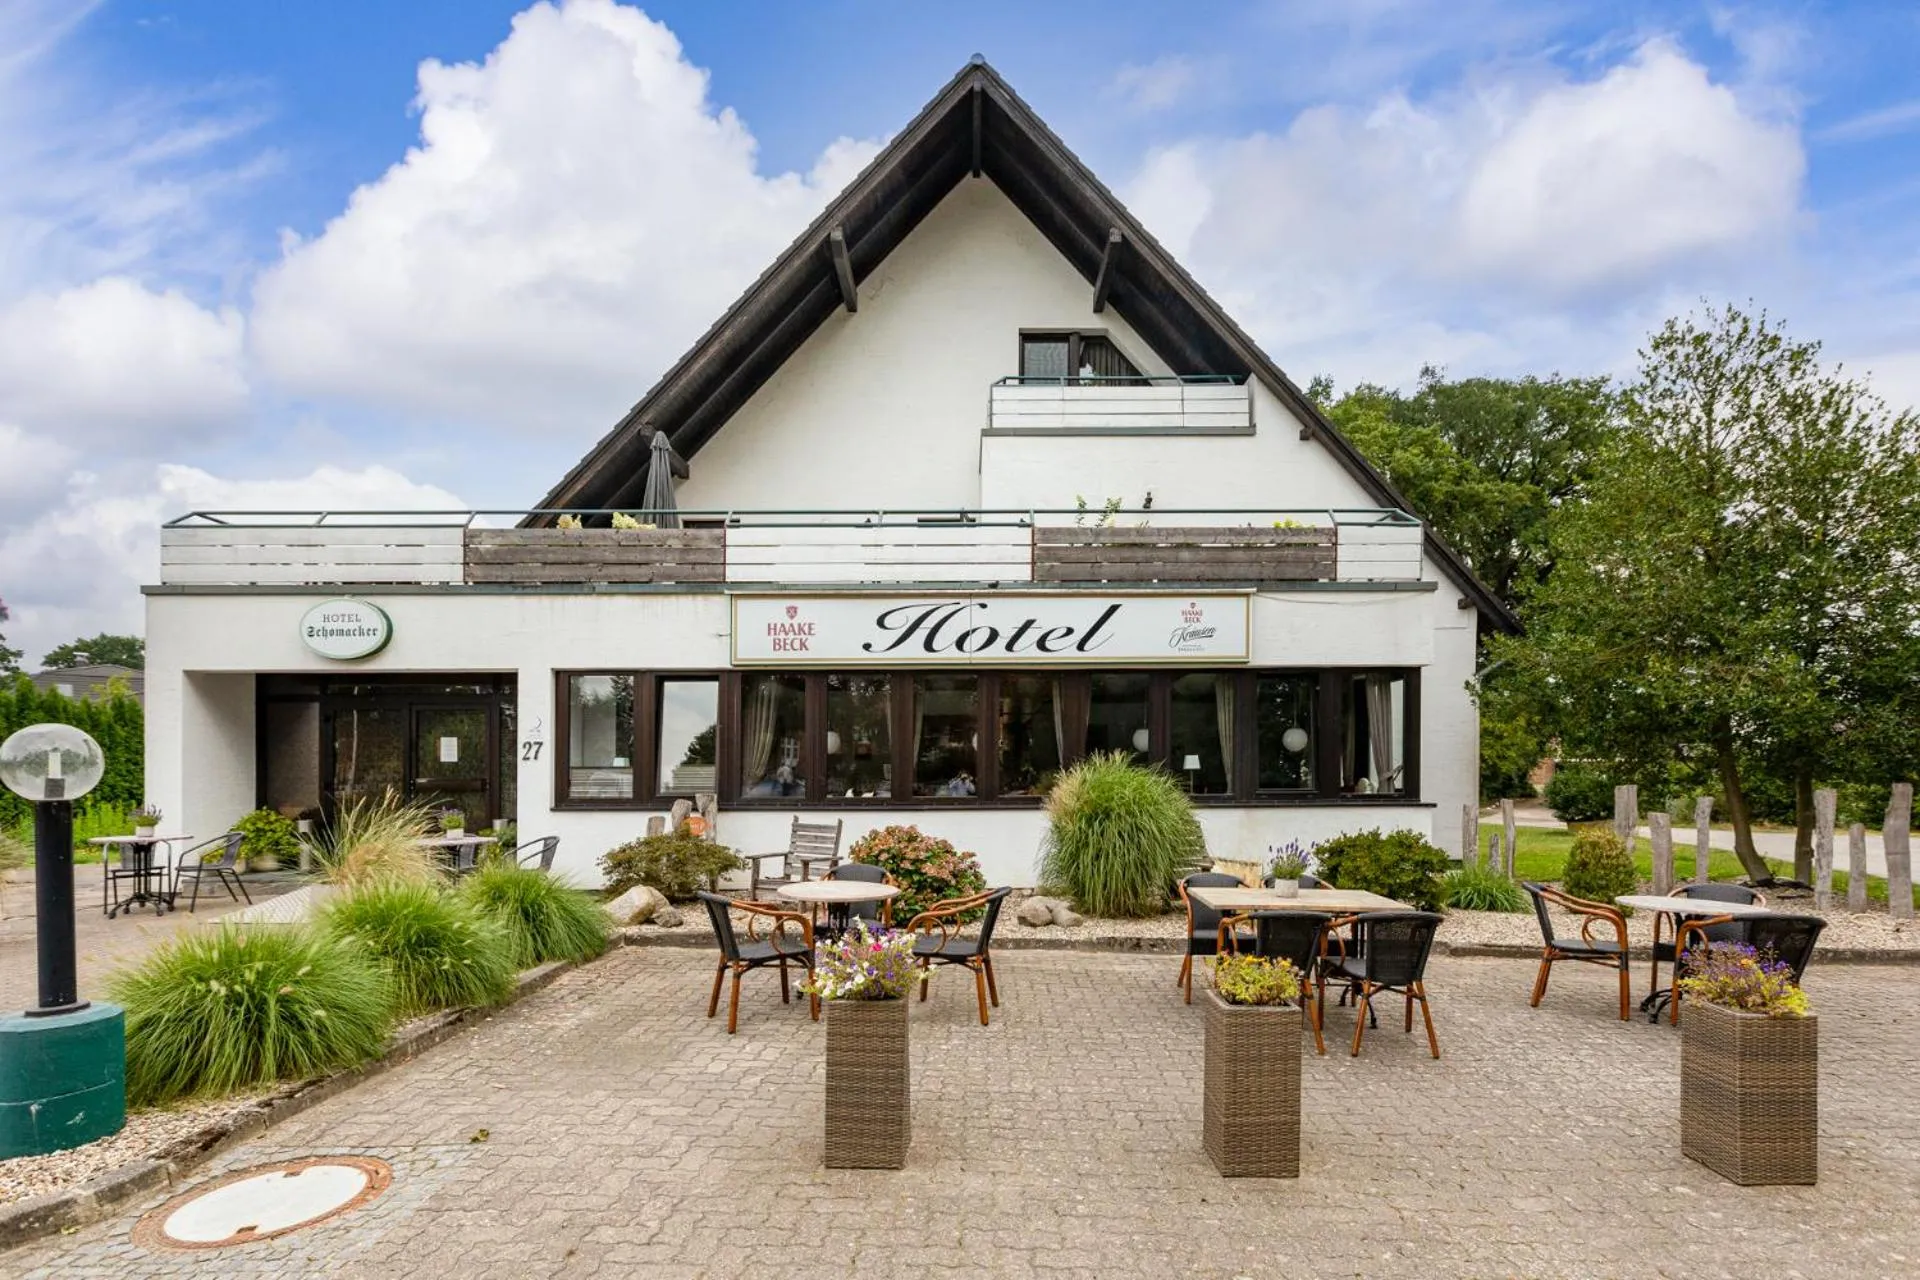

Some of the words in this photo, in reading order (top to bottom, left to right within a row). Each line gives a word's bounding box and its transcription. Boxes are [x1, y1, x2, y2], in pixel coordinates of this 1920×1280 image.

[322, 613, 362, 623] HOTEL
[306, 625, 378, 640] Schomacker
[767, 622, 816, 636] HAAKE
[862, 602, 1123, 653] Hotel
[772, 637, 810, 651] BECK
[522, 741, 543, 761] 27
